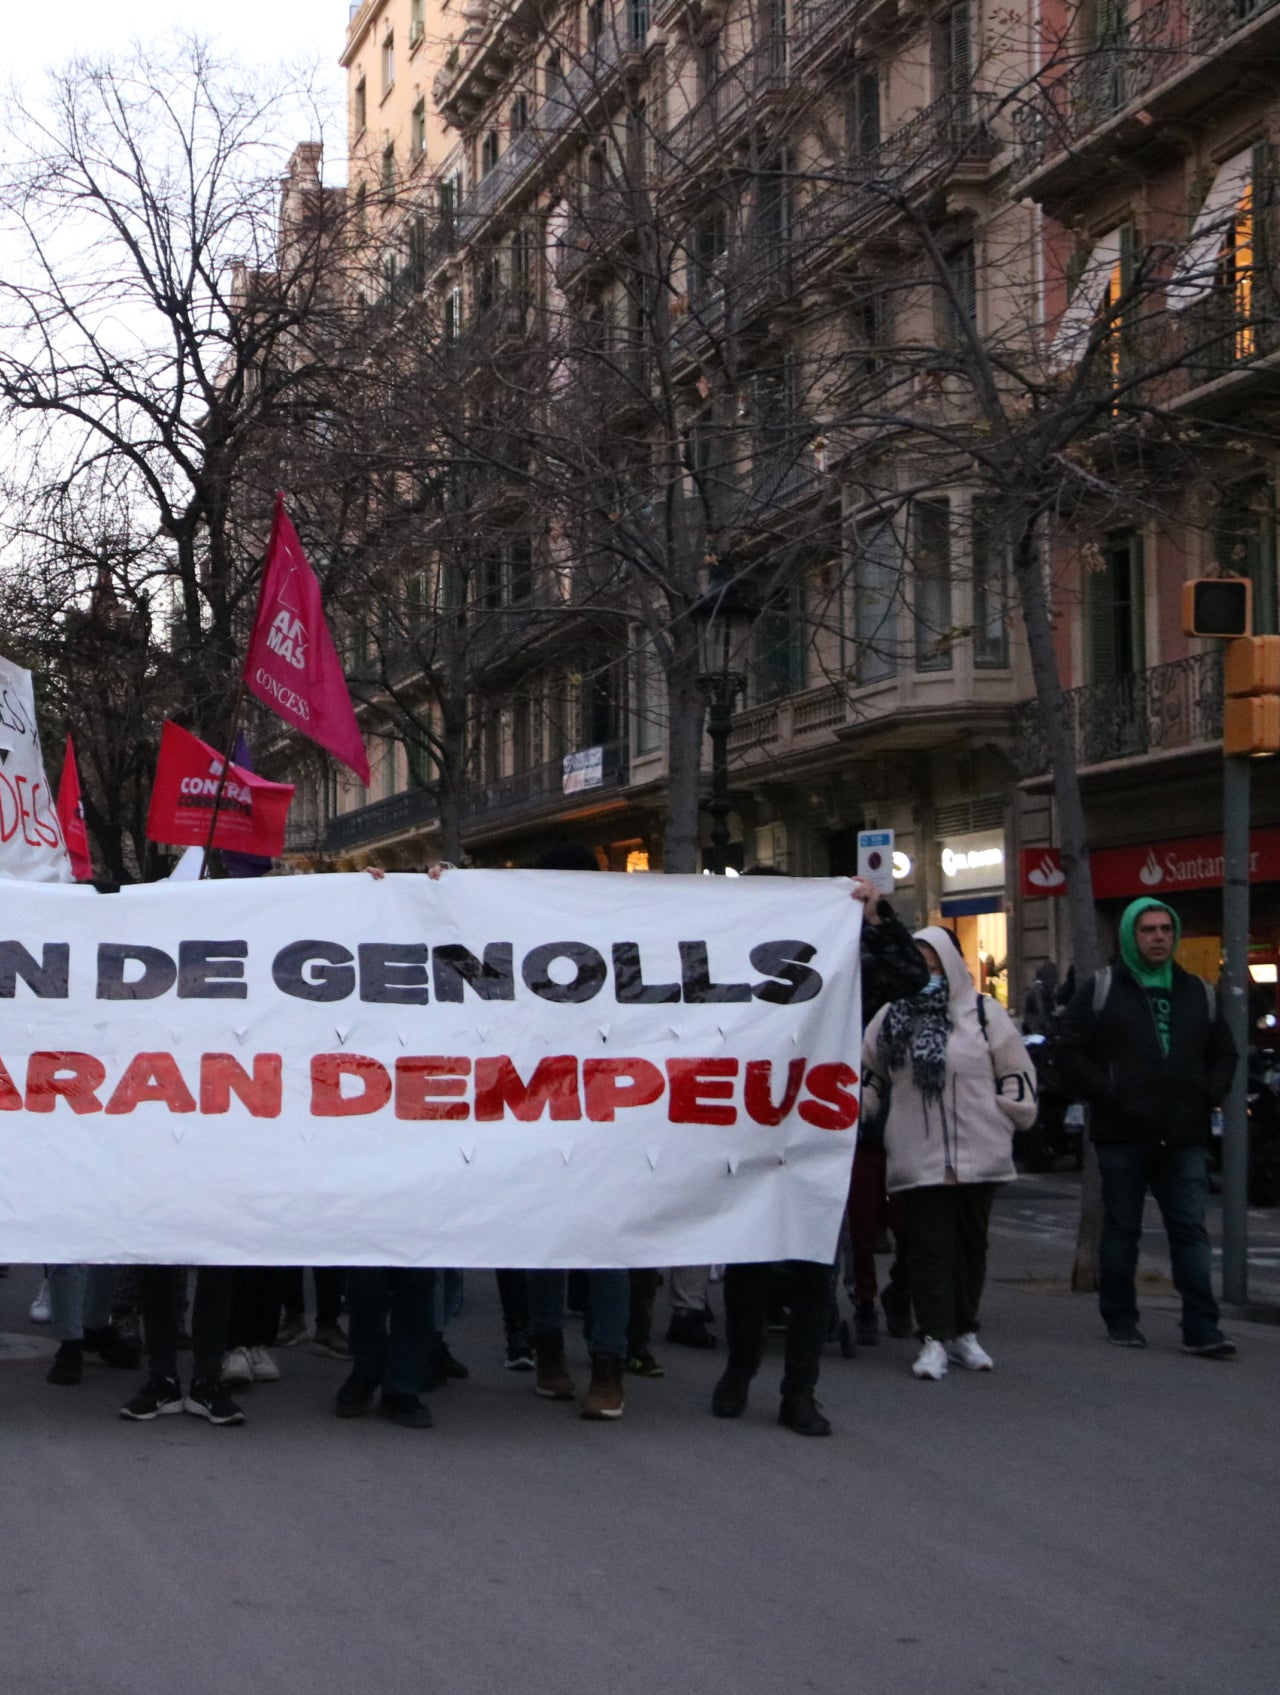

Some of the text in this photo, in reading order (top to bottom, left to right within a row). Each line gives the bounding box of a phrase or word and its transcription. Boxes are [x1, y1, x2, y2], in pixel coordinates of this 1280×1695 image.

[1164, 852, 1259, 882] Santanr
[97, 940, 248, 1001] DE
[272, 939, 823, 1006] GENOLLS
[310, 1053, 860, 1130] DEMPEUS
